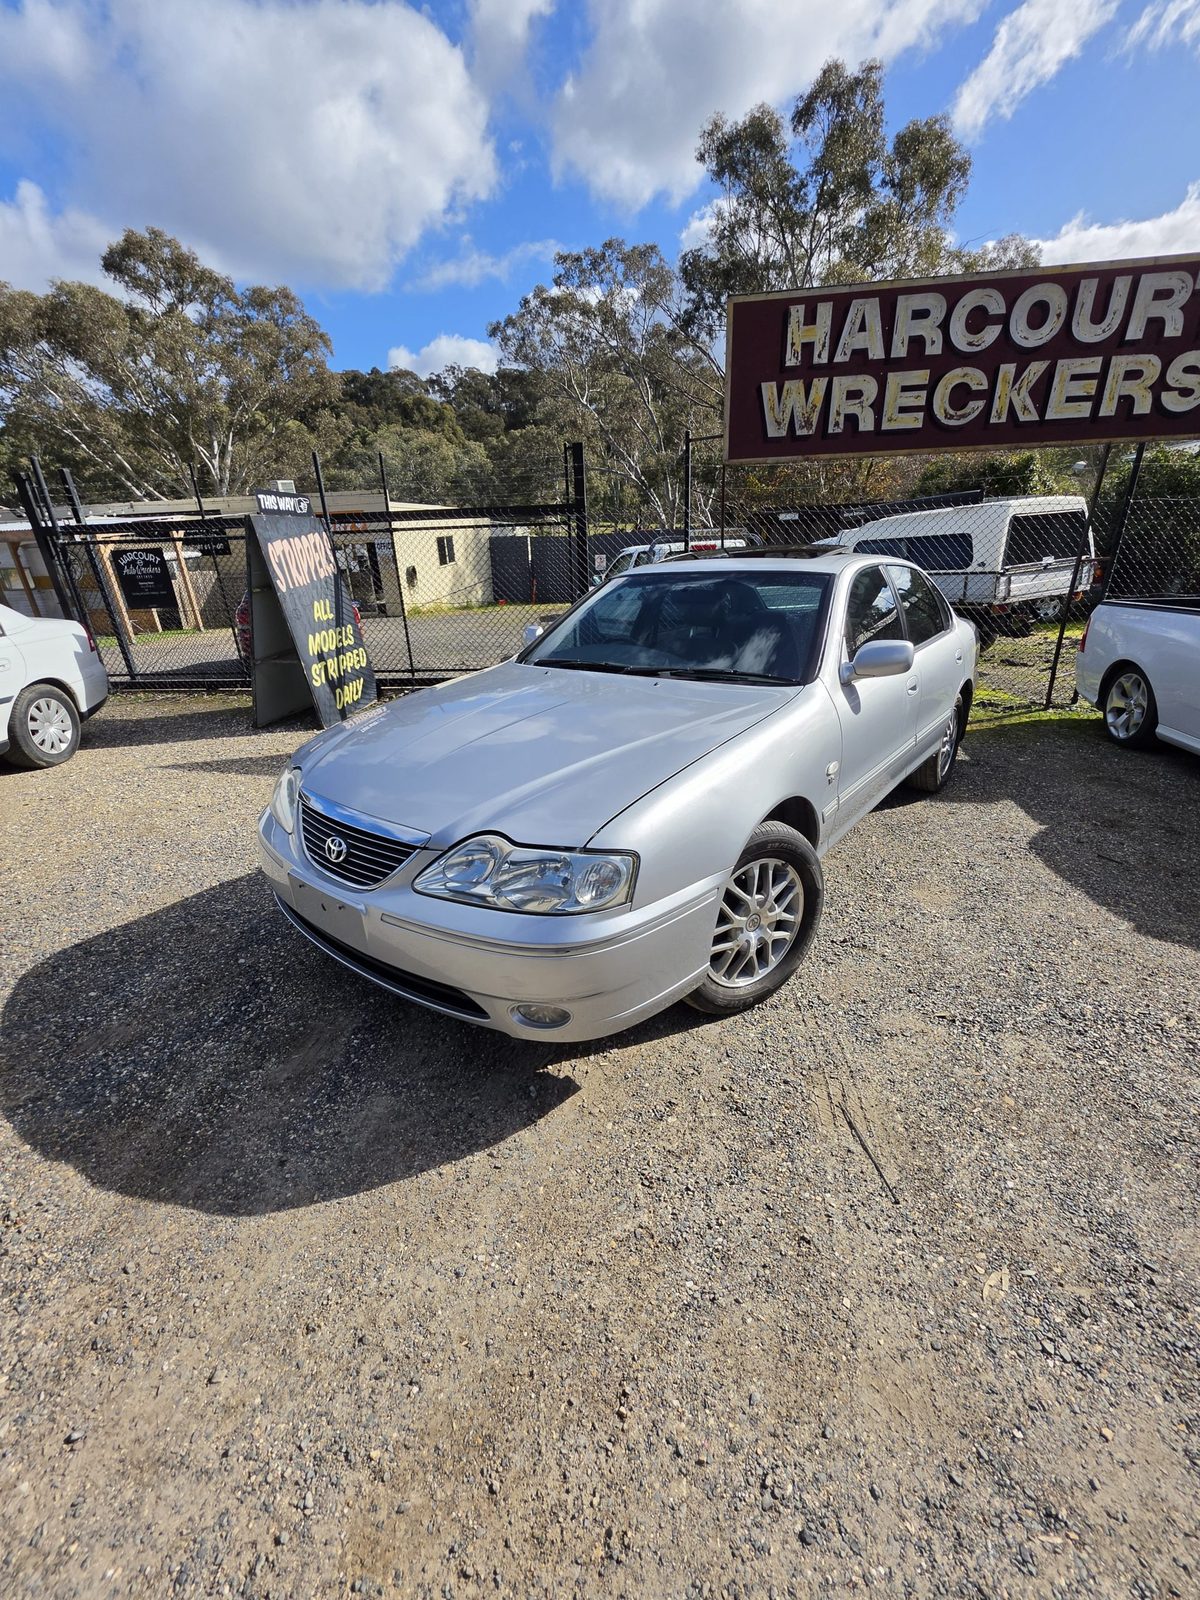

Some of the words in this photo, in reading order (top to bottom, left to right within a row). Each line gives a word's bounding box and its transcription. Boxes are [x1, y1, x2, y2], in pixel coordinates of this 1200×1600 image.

[785, 270, 1200, 366] HARCOUR
[761, 350, 1200, 438] WRECKERS
[257, 495, 278, 509] THIS
[277, 496, 295, 511] WAY
[118, 551, 161, 566] HARCOURT
[123, 564, 137, 575] Auto
[135, 565, 161, 574] Wreckers
[268, 531, 337, 592] STRIPPERS
[313, 599, 334, 622] ALL
[308, 625, 354, 656] MODELS
[312, 648, 367, 687] STRIPPED
[336, 678, 364, 710] DAILY
